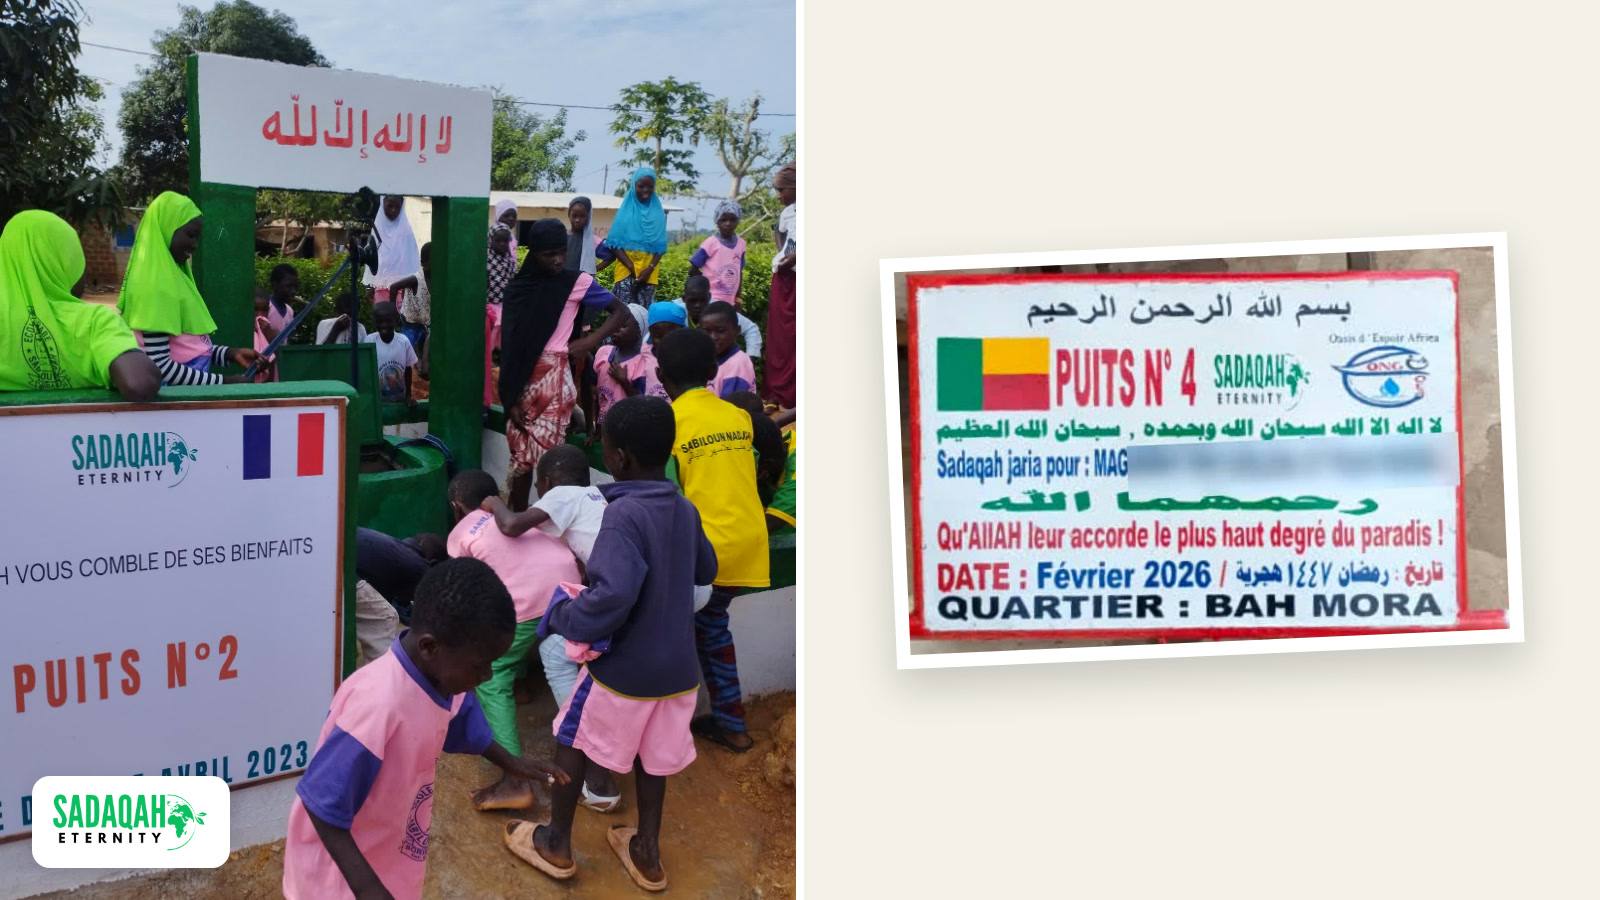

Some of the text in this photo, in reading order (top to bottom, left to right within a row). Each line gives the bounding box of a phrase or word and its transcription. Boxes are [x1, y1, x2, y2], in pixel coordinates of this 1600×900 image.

[1027, 291, 1351, 327] بسم الله الرحمن الرحيم
[1329, 333, 1356, 344] Oasis
[1408, 332, 1440, 343] Africa
[1056, 347, 1135, 409] PUITS
[1181, 347, 1197, 408] 4
[1214, 353, 1286, 390] SADAQAH
[1367, 361, 1404, 371] ONG
[1217, 392, 1284, 406] ETERNITY
[936, 418, 1010, 444] العظيم
[1014, 418, 1048, 439] الله
[1054, 418, 1121, 442] سبحان
[1143, 419, 1217, 441] وبحمده
[1221, 418, 1253, 438] الله
[1260, 417, 1326, 441] سبحان
[1331, 417, 1363, 437] الله
[1370, 417, 1389, 436] الا
[1397, 417, 1422, 435] اله
[1429, 417, 1442, 434] لا
[71, 432, 167, 471] SADAQAH
[680, 432, 726, 454] SABILOUN
[78, 469, 163, 486] ETERNITY
[937, 450, 1003, 484] Sadaqah
[1007, 450, 1042, 484] jaria
[1046, 454, 1081, 483] pour
[981, 489, 1379, 516] رحمهما الله
[1028, 521, 1066, 550] leur
[1070, 520, 1149, 549] accorde
[1154, 520, 1171, 548] le
[1178, 519, 1217, 554] plus
[1222, 519, 1264, 548] haut
[1270, 518, 1326, 555] degré
[1331, 518, 1355, 548] du
[1361, 518, 1432, 554] paradis
[15, 560, 73, 584] VOUS
[79, 552, 159, 578] COMBLE
[164, 549, 188, 569] DE
[193, 546, 226, 566] SES
[231, 537, 314, 562] BIENFAITS
[1338, 560, 1389, 587] رمضان
[1404, 560, 1443, 587] تاريخ
[937, 562, 1010, 592] DATE
[1037, 561, 1135, 590] Février
[1143, 560, 1212, 589] 2026
[1235, 560, 1282, 588] هجرية
[937, 594, 1164, 621] QUARTIER
[1206, 594, 1296, 618] BAH
[1312, 592, 1443, 618] MORA
[13, 648, 141, 714] PUITS
[247, 740, 308, 779] 2023
